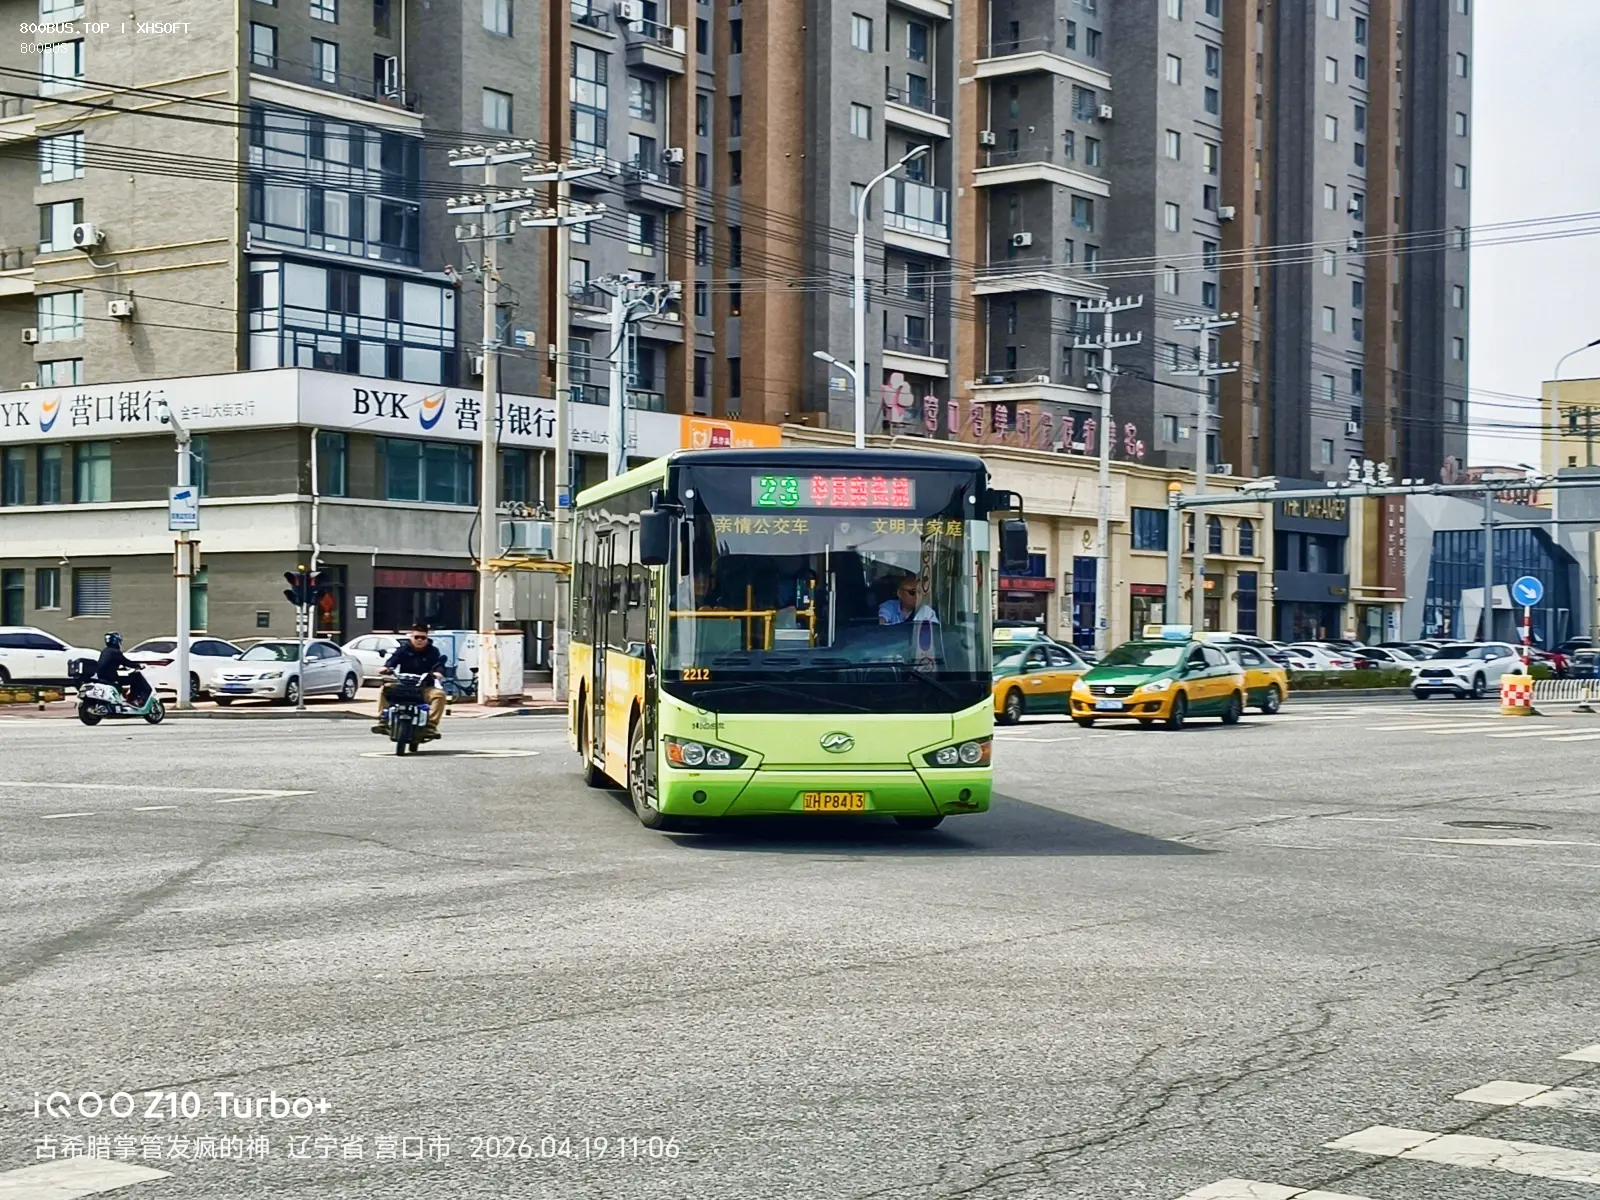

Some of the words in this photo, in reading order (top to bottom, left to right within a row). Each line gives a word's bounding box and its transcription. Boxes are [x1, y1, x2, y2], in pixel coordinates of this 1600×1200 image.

[69, 389, 165, 427] 营口银行
[353, 388, 409, 419] BYK
[758, 475, 800, 508] 23
[714, 517, 809, 535] 亲情公交车
[871, 517, 963, 537] 文明大家庭
[682, 668, 710, 681] 2212
